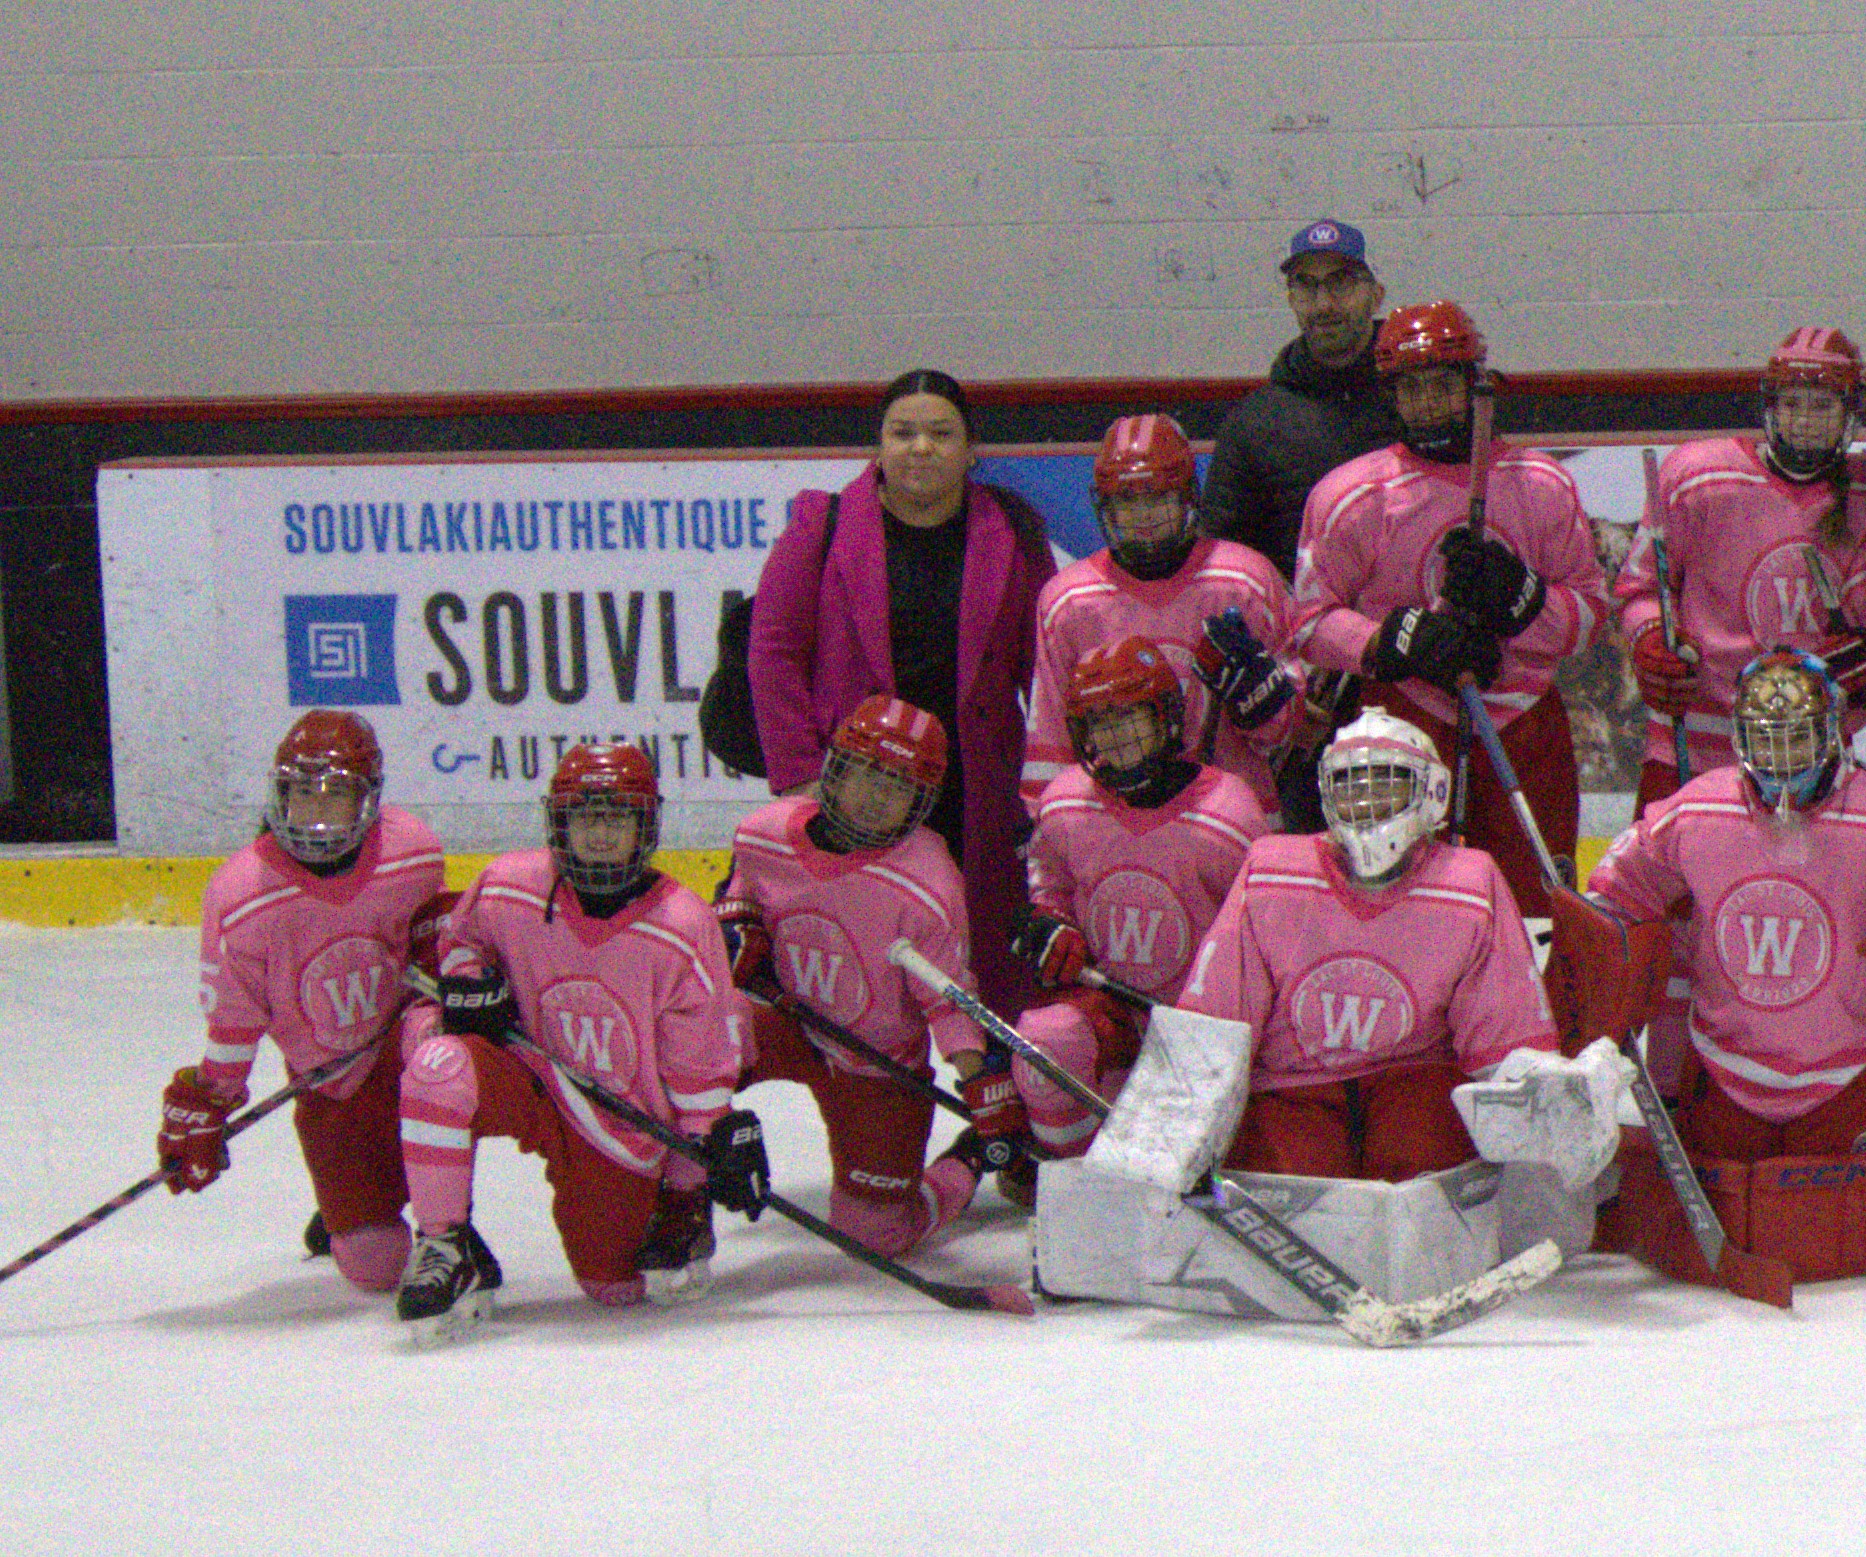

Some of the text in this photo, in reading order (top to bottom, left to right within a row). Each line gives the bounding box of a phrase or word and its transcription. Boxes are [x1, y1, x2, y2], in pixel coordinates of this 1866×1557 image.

[1315, 229, 1328, 240] W
[423, 590, 743, 706] SOUVL
[490, 734, 742, 781] AUTNTI
[1109, 905, 1162, 964] W
[1740, 914, 1803, 976] W
[323, 966, 382, 1027] W
[786, 943, 842, 1004] W
[559, 1011, 615, 1072] W
[1321, 992, 1386, 1053] W
[421, 1044, 454, 1069] W
[849, 1169, 911, 1190] CCM
